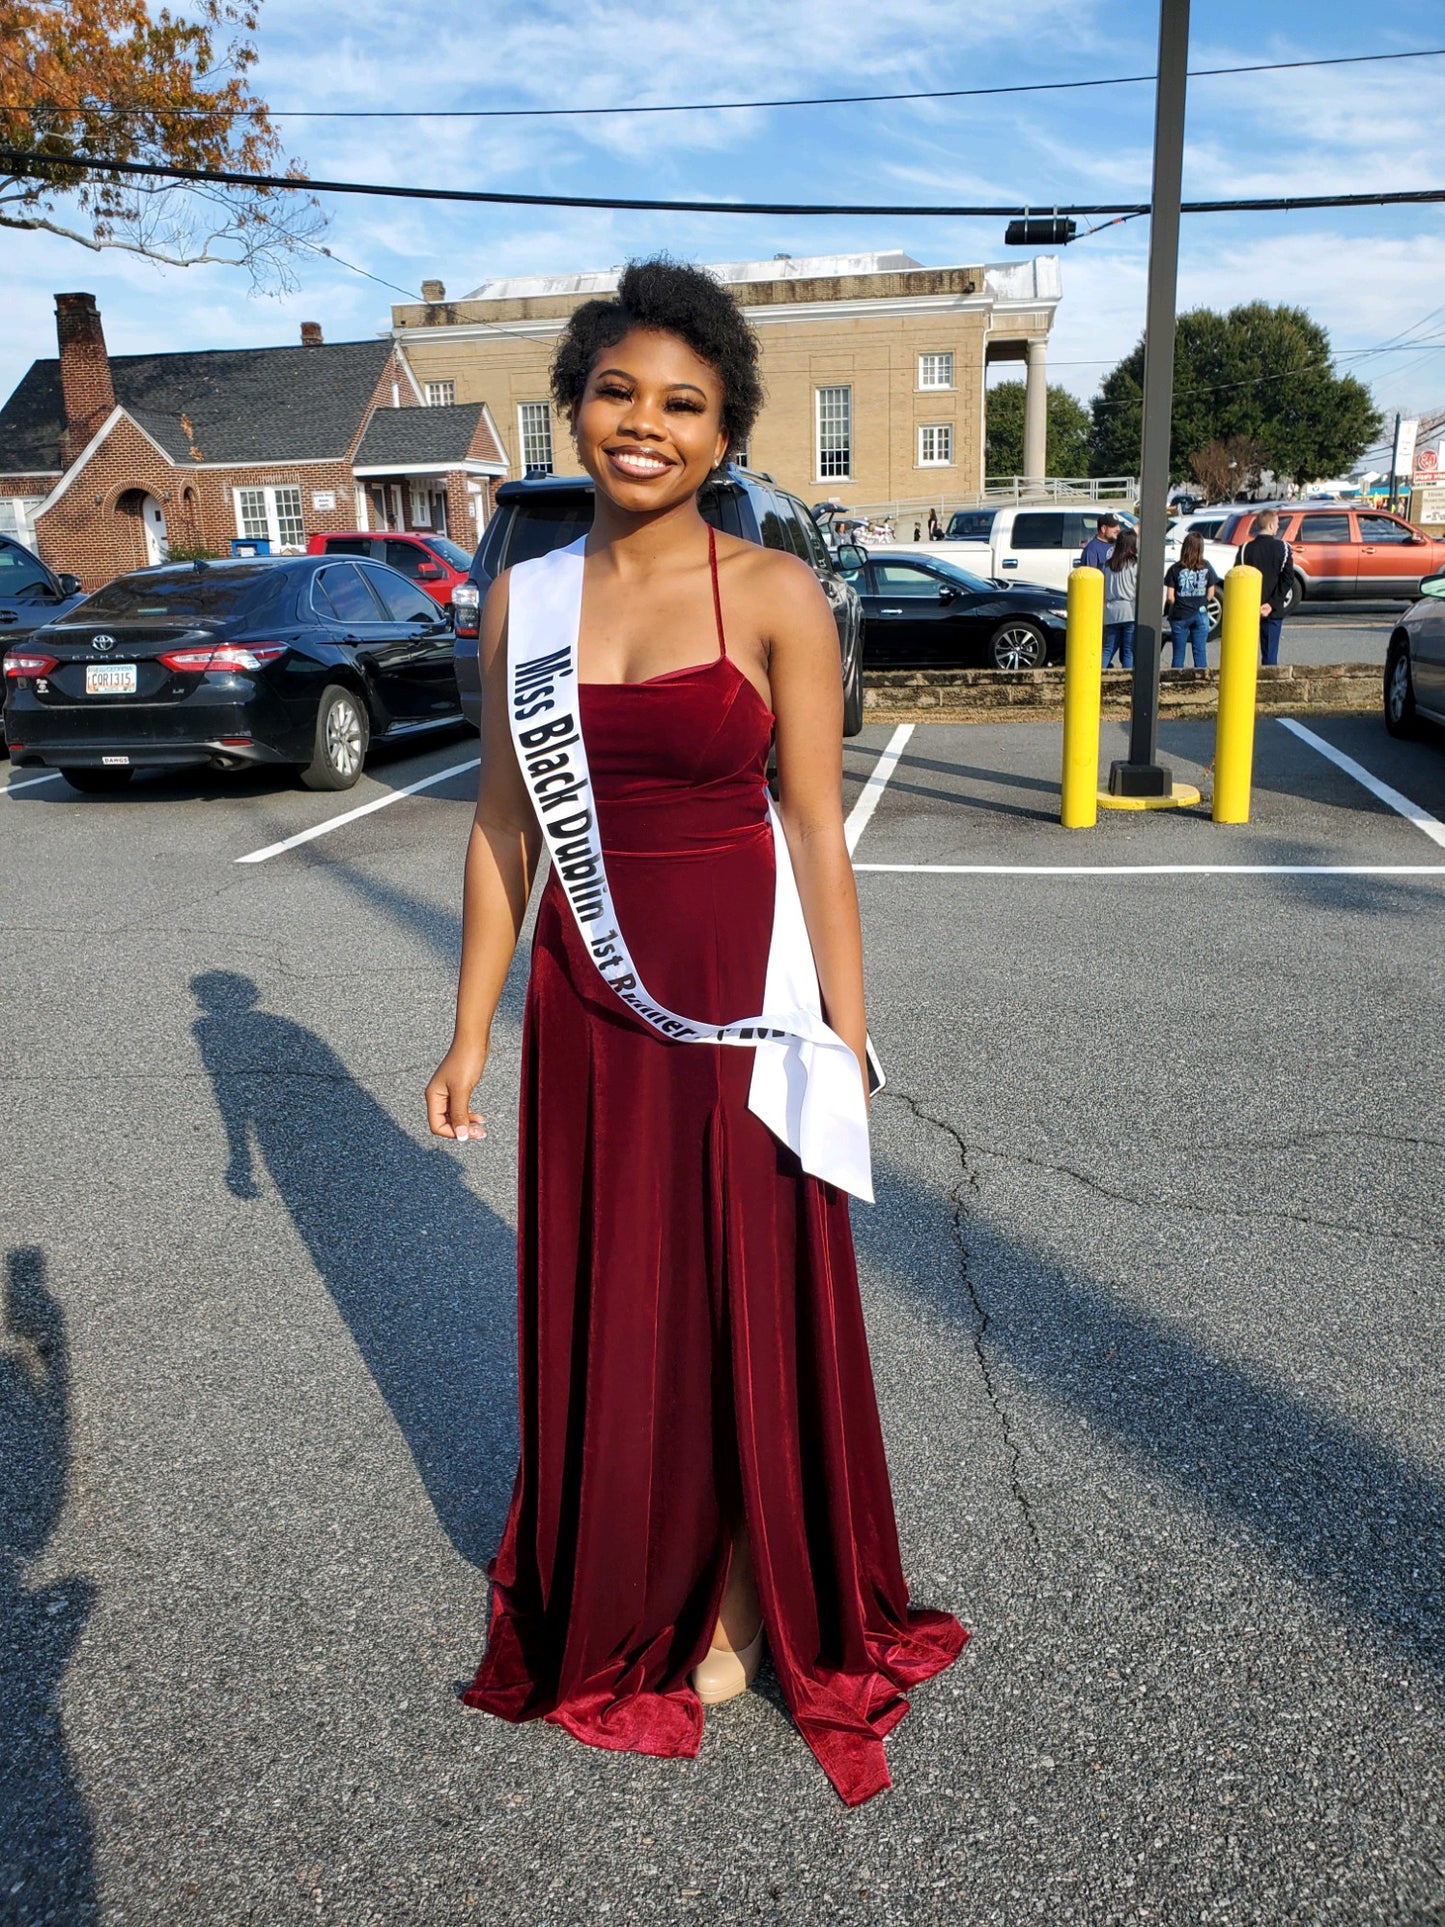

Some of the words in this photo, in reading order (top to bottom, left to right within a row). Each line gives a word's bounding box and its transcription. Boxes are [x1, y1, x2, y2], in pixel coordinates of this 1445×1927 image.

[515, 645, 572, 721] Miss
[518, 712, 588, 812] Black
[547, 809, 608, 923] Dublin
[590, 929, 622, 972] 1st
